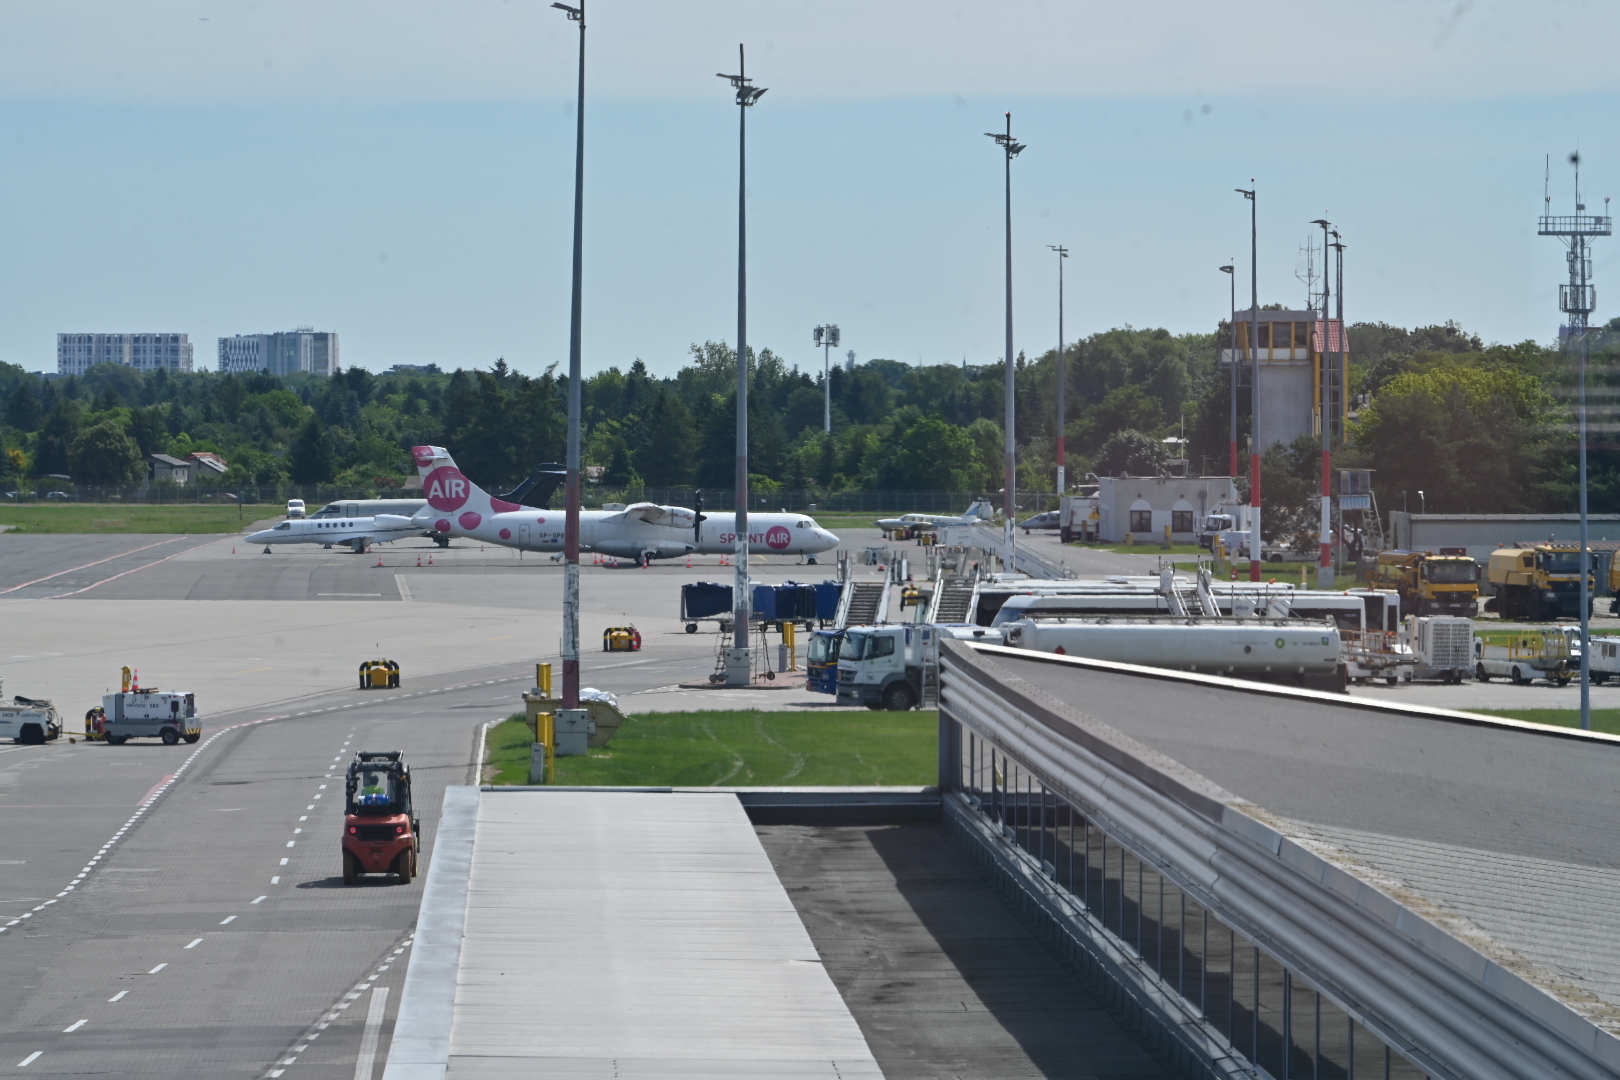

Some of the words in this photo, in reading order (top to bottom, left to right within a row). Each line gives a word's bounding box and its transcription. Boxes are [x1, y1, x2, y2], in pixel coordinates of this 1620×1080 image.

[428, 479, 466, 499] AIR
[719, 533, 765, 544] SPNT
[768, 532, 789, 544] AIR
